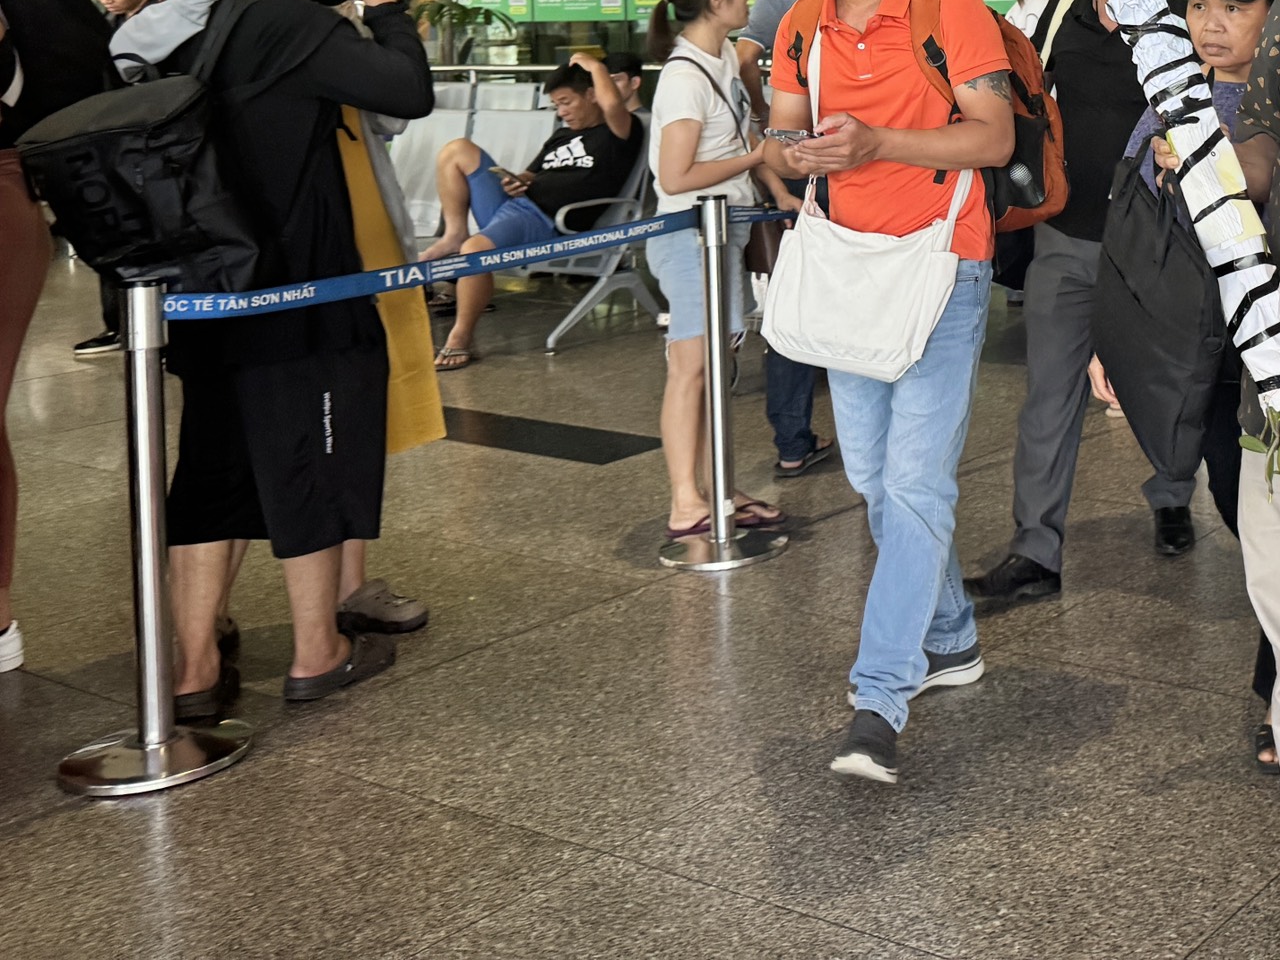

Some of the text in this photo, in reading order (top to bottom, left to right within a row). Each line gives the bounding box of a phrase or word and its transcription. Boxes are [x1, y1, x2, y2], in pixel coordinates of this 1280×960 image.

[480, 220, 666, 267] TAN SON NHAT INTERNATIONAL AIRPORT
[379, 266, 425, 287] TIA
[192, 294, 215, 312] TẾ
[217, 295, 248, 311] TÂN
[251, 291, 280, 307] SƠN
[282, 283, 316, 302] NHẤT
